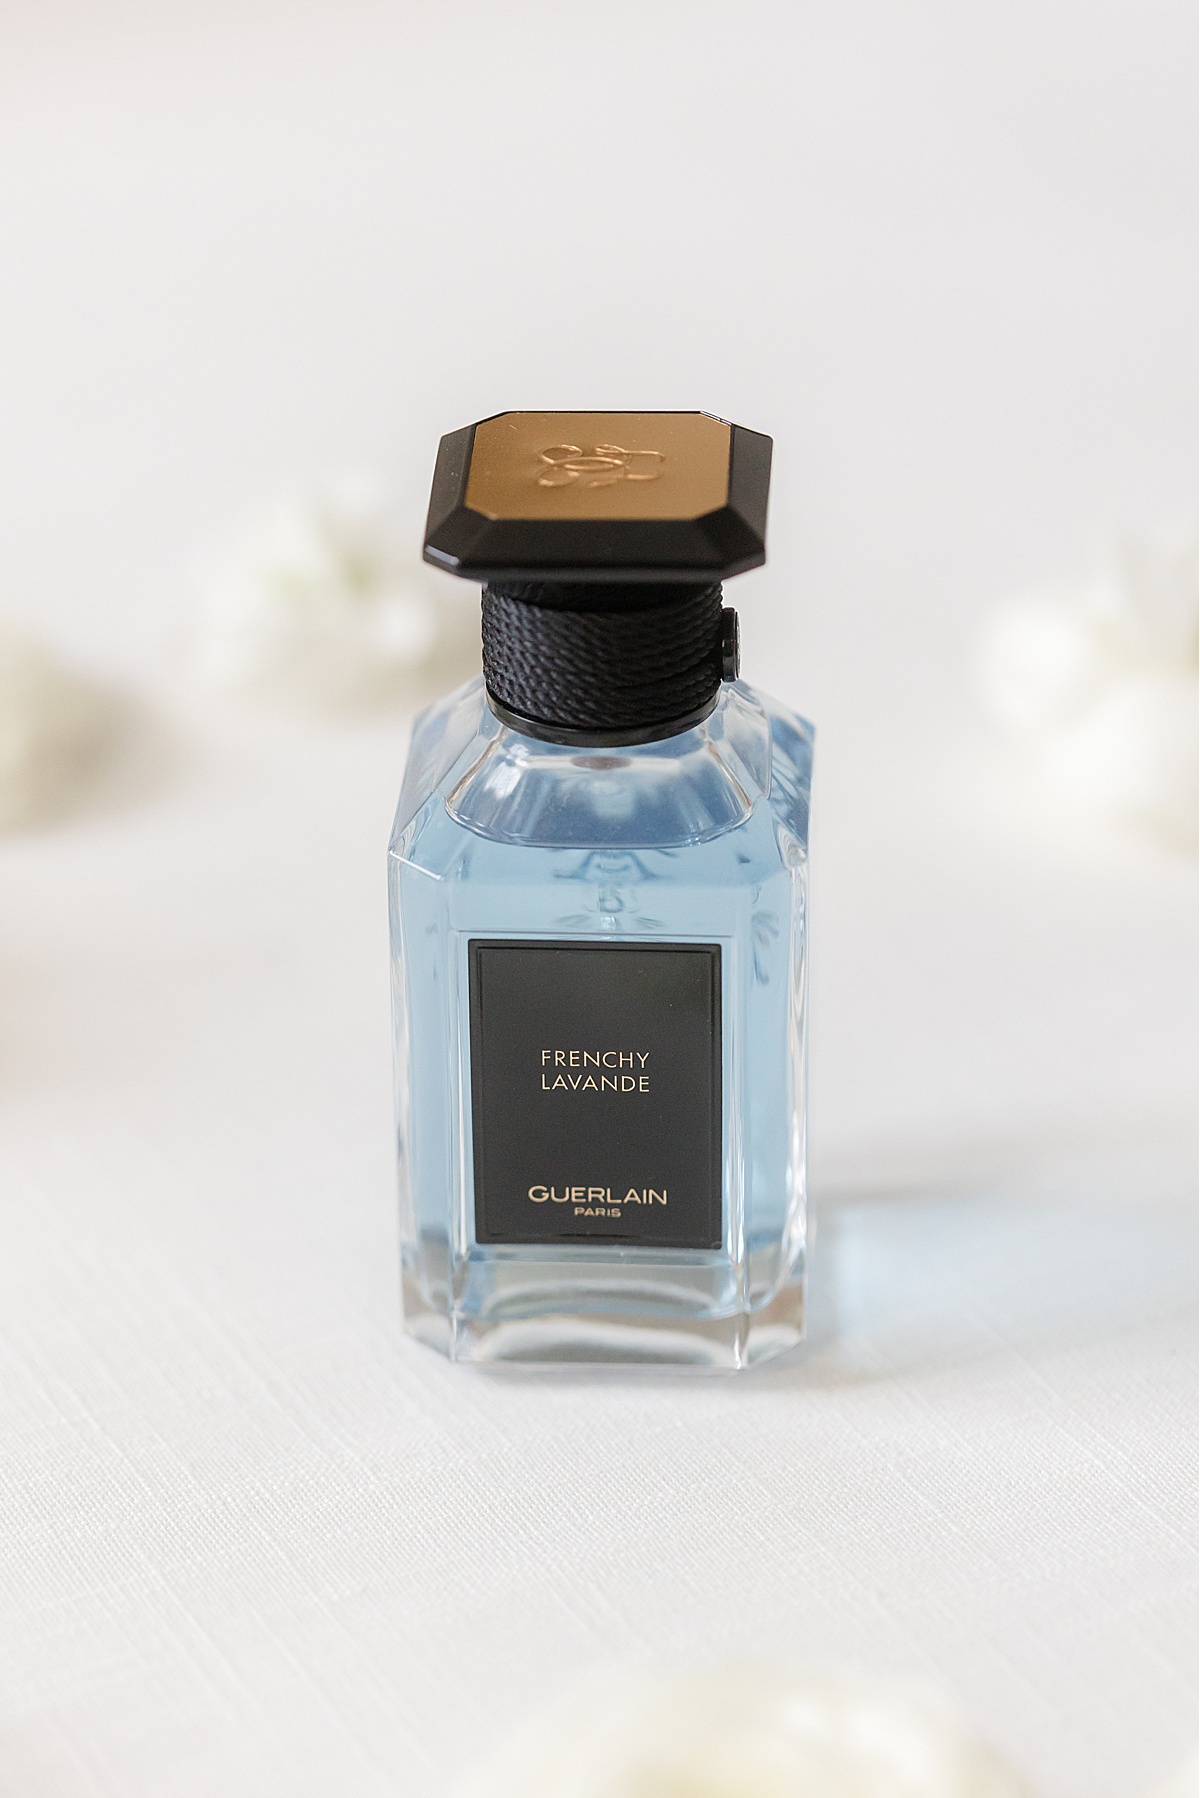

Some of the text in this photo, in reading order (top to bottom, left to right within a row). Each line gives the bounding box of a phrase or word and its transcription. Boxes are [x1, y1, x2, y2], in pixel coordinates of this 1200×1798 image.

[541, 1049, 650, 1069] FRENCHY
[541, 1073, 650, 1093] LAVANDE
[527, 1185, 668, 1205] GUERLAIN
[574, 1206, 622, 1218] PARIS
